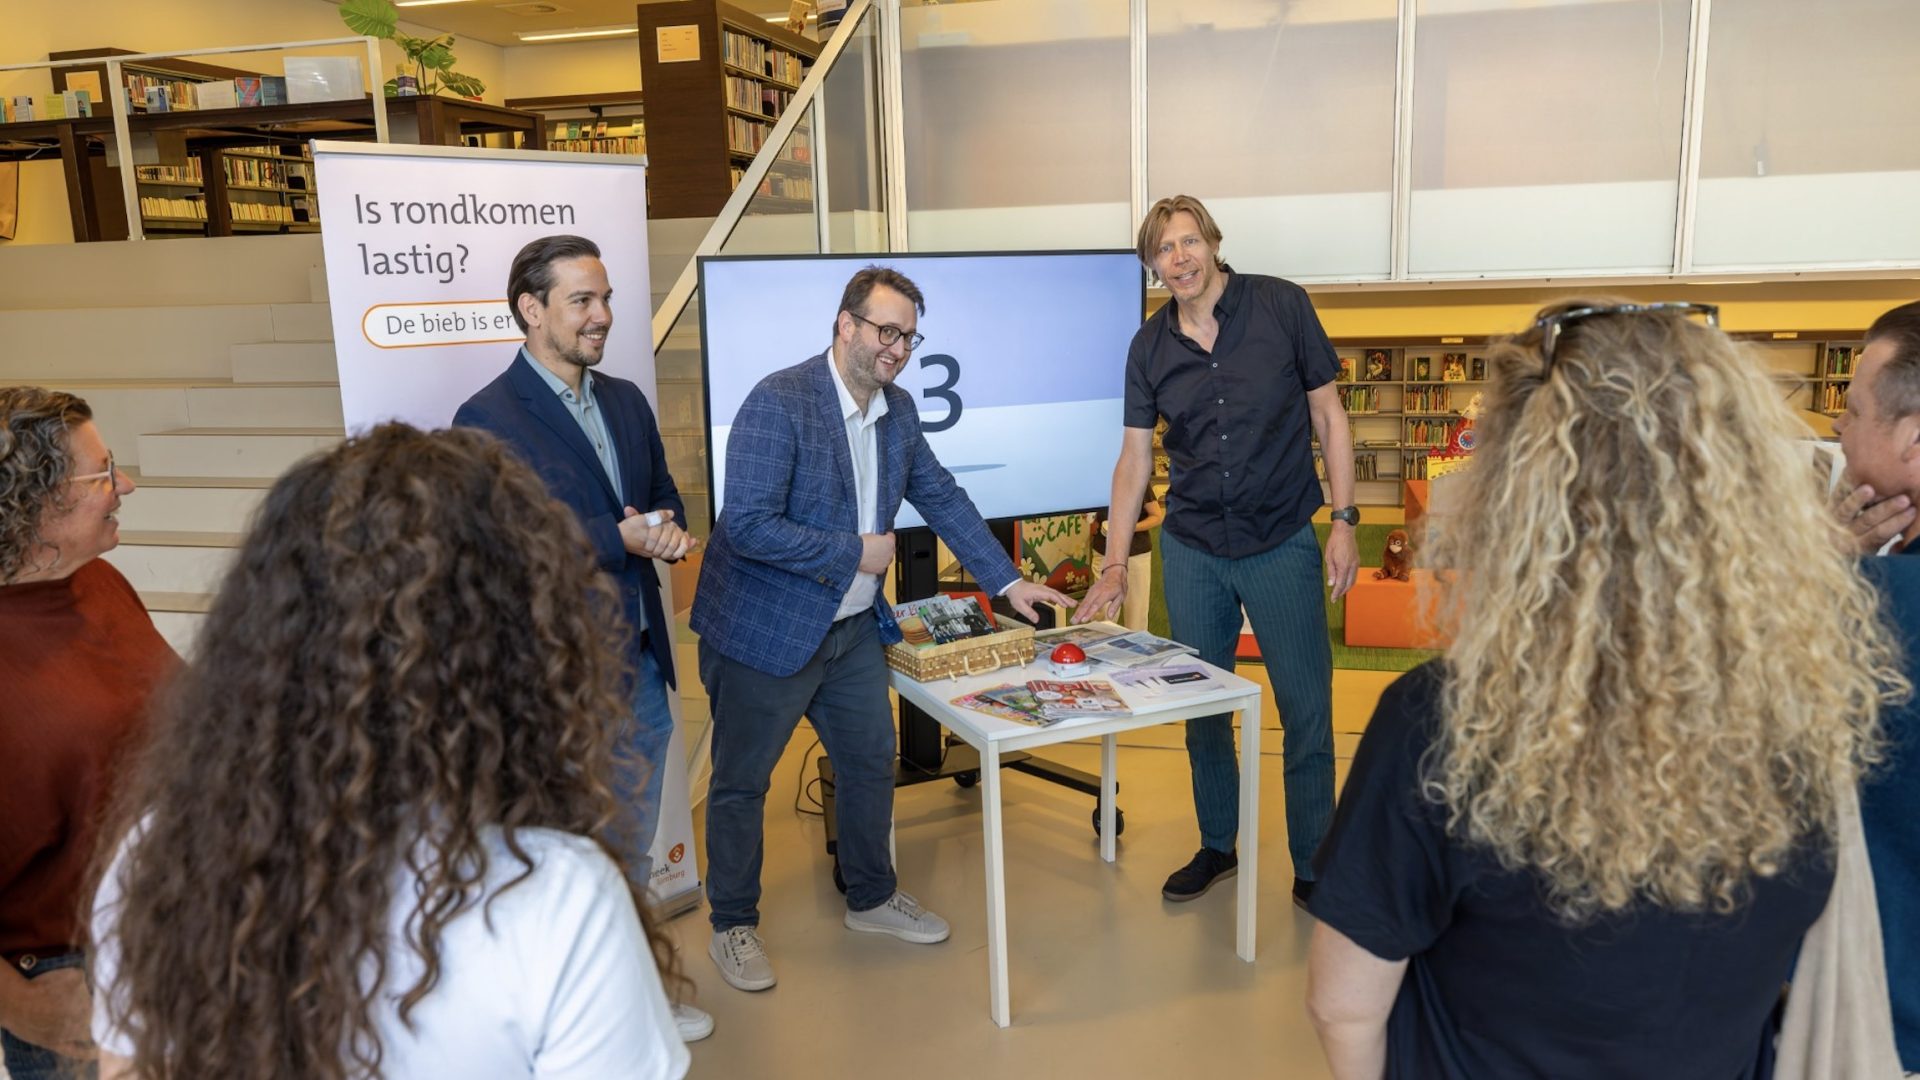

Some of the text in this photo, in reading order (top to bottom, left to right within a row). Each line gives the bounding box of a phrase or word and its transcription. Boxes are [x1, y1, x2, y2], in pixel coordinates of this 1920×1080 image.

[355, 193, 575, 225] Is rondkomen
[357, 243, 469, 284] lastig?
[386, 312, 513, 335] De bieb is er
[919, 353, 963, 433] 3
